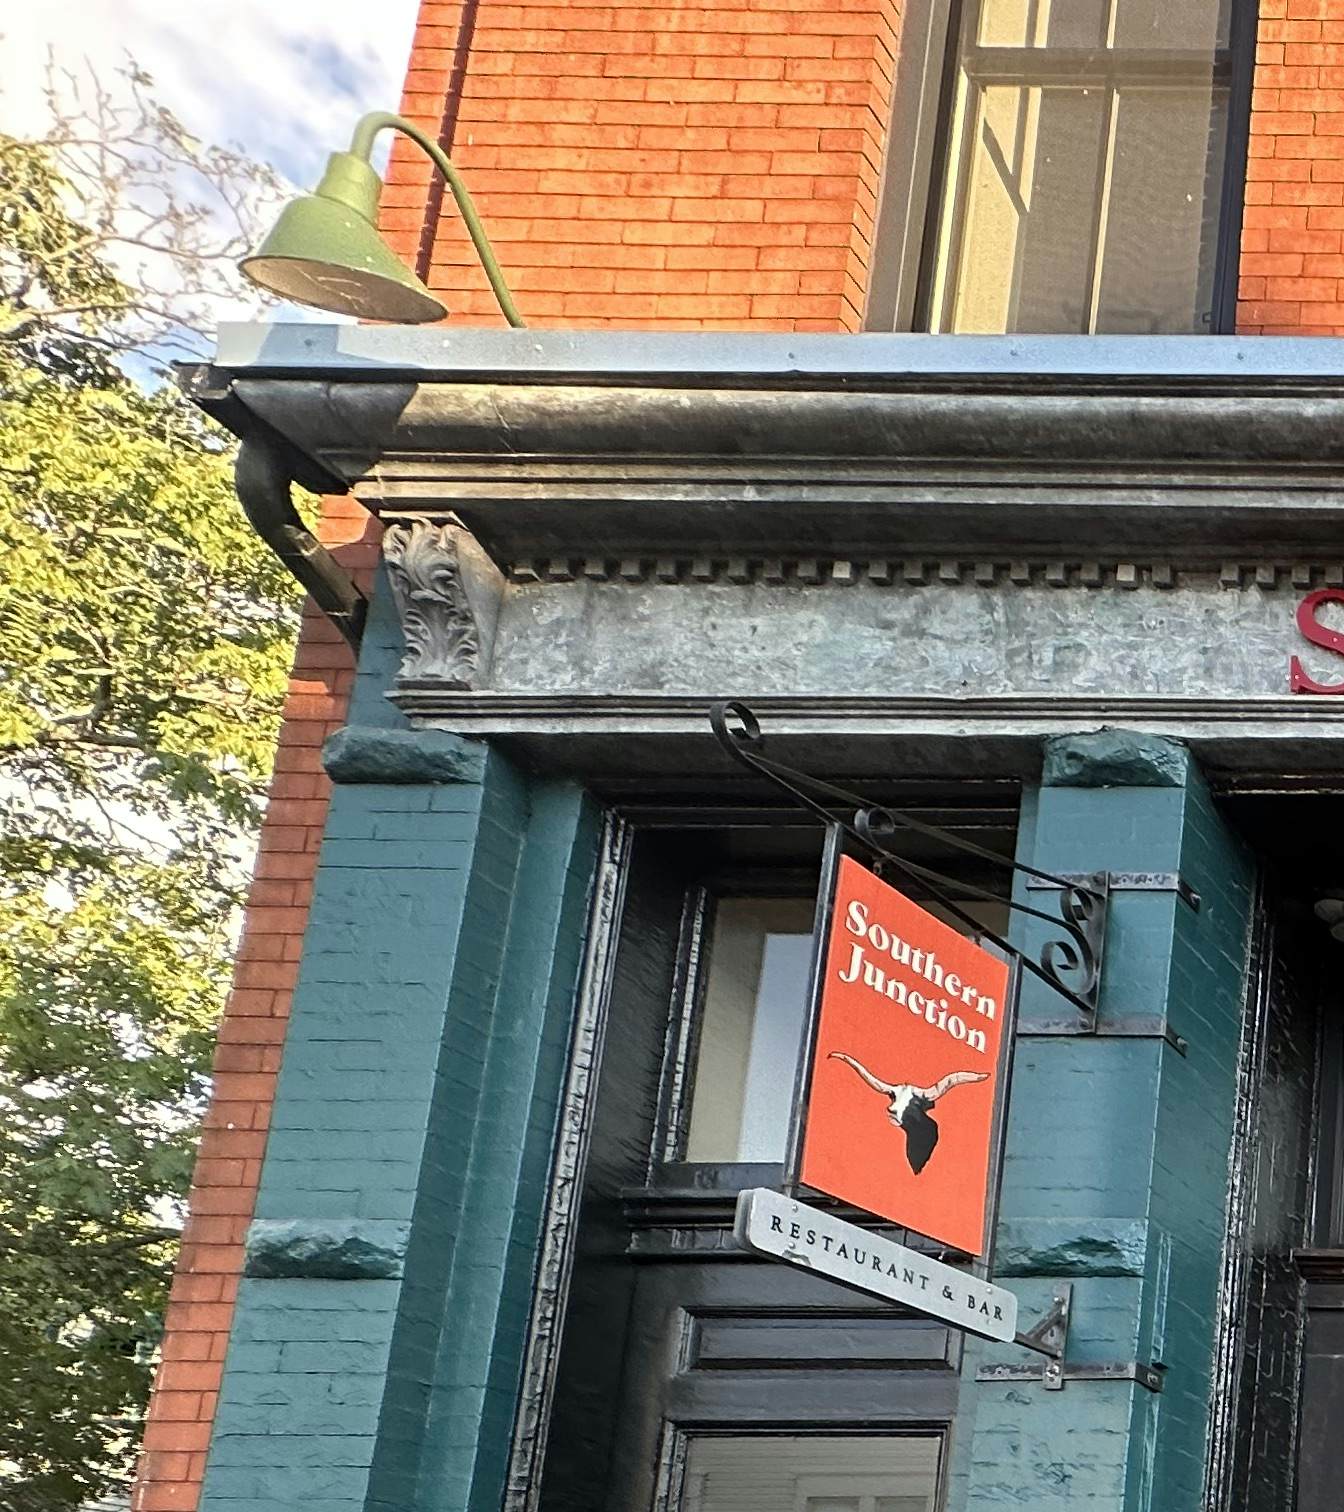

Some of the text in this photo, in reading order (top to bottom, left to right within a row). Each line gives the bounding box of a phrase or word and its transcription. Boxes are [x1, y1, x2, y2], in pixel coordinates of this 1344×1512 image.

[838, 940, 989, 1055] Junction
[844, 898, 997, 1022] Southern
[770, 1214, 1005, 1322] RESTAURANT & BAR
